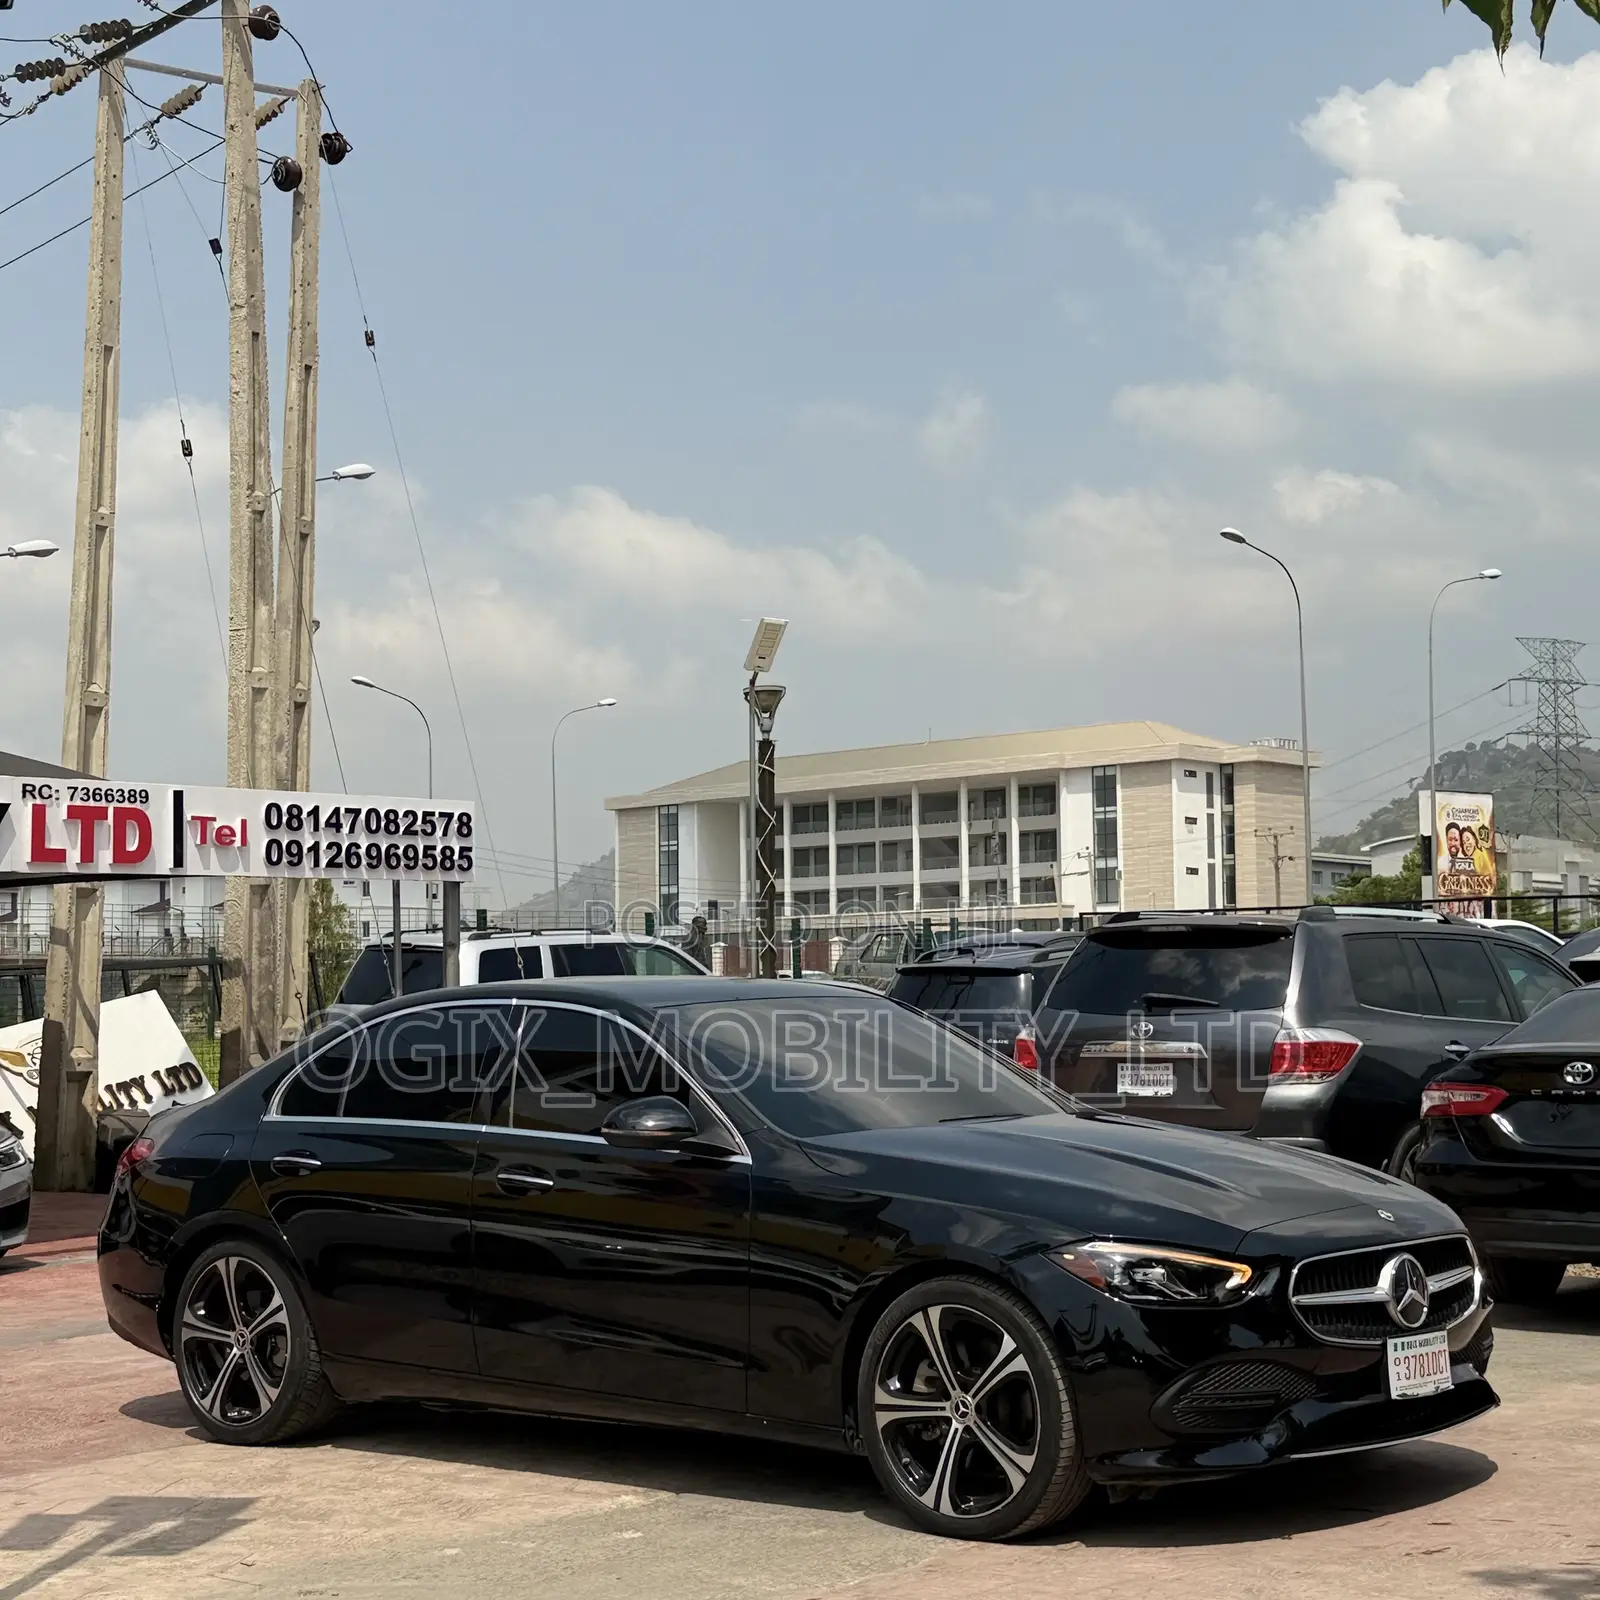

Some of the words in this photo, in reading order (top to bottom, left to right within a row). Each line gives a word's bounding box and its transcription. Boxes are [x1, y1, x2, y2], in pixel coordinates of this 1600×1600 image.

[21, 784, 60, 801] RC:
[67, 786, 149, 804] 7366389
[30, 804, 152, 863] LTD
[190, 815, 248, 848] Tel
[264, 802, 473, 838] 08147082578
[264, 838, 473, 872] 09126969585
[151, 1062, 203, 1097] LTD
